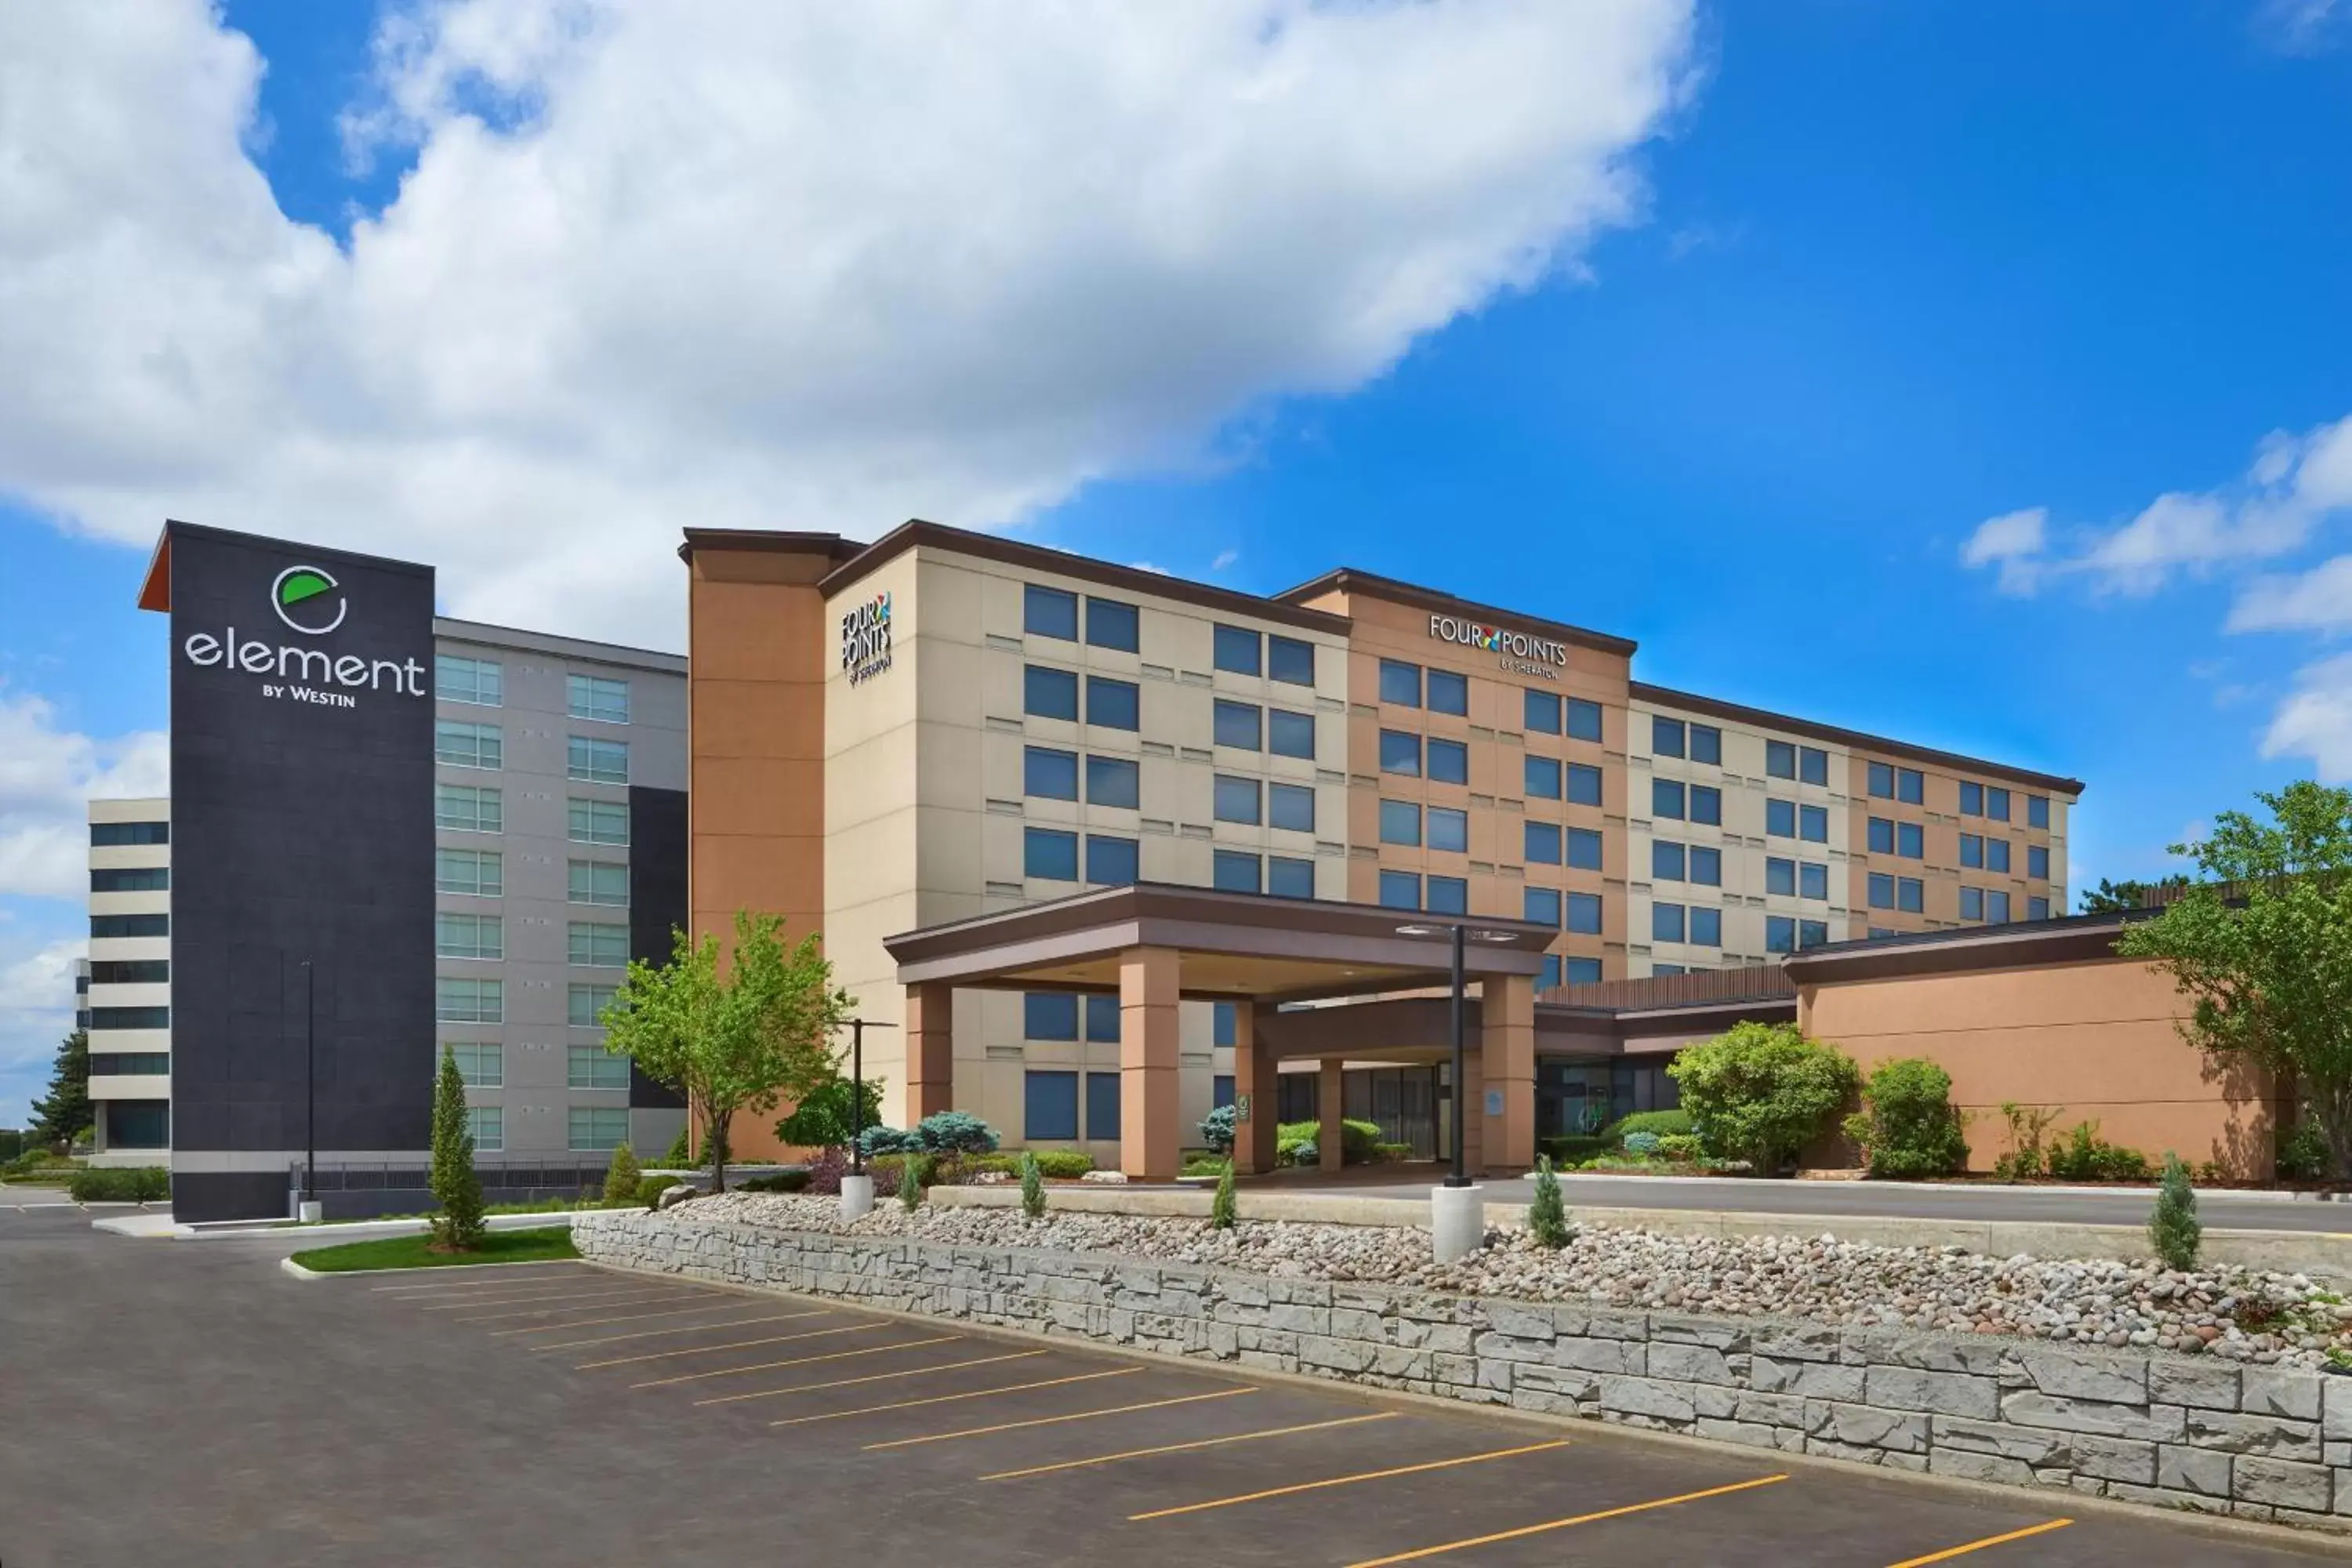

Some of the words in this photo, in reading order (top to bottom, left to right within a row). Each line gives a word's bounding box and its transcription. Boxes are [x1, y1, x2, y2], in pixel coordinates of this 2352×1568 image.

[842, 600, 877, 640] FOUR
[842, 620, 891, 668] POINTS
[1430, 615, 1483, 649] FOUR
[1502, 632, 1566, 666] POINTS
[185, 626, 426, 696] element
[263, 684, 284, 699] BY
